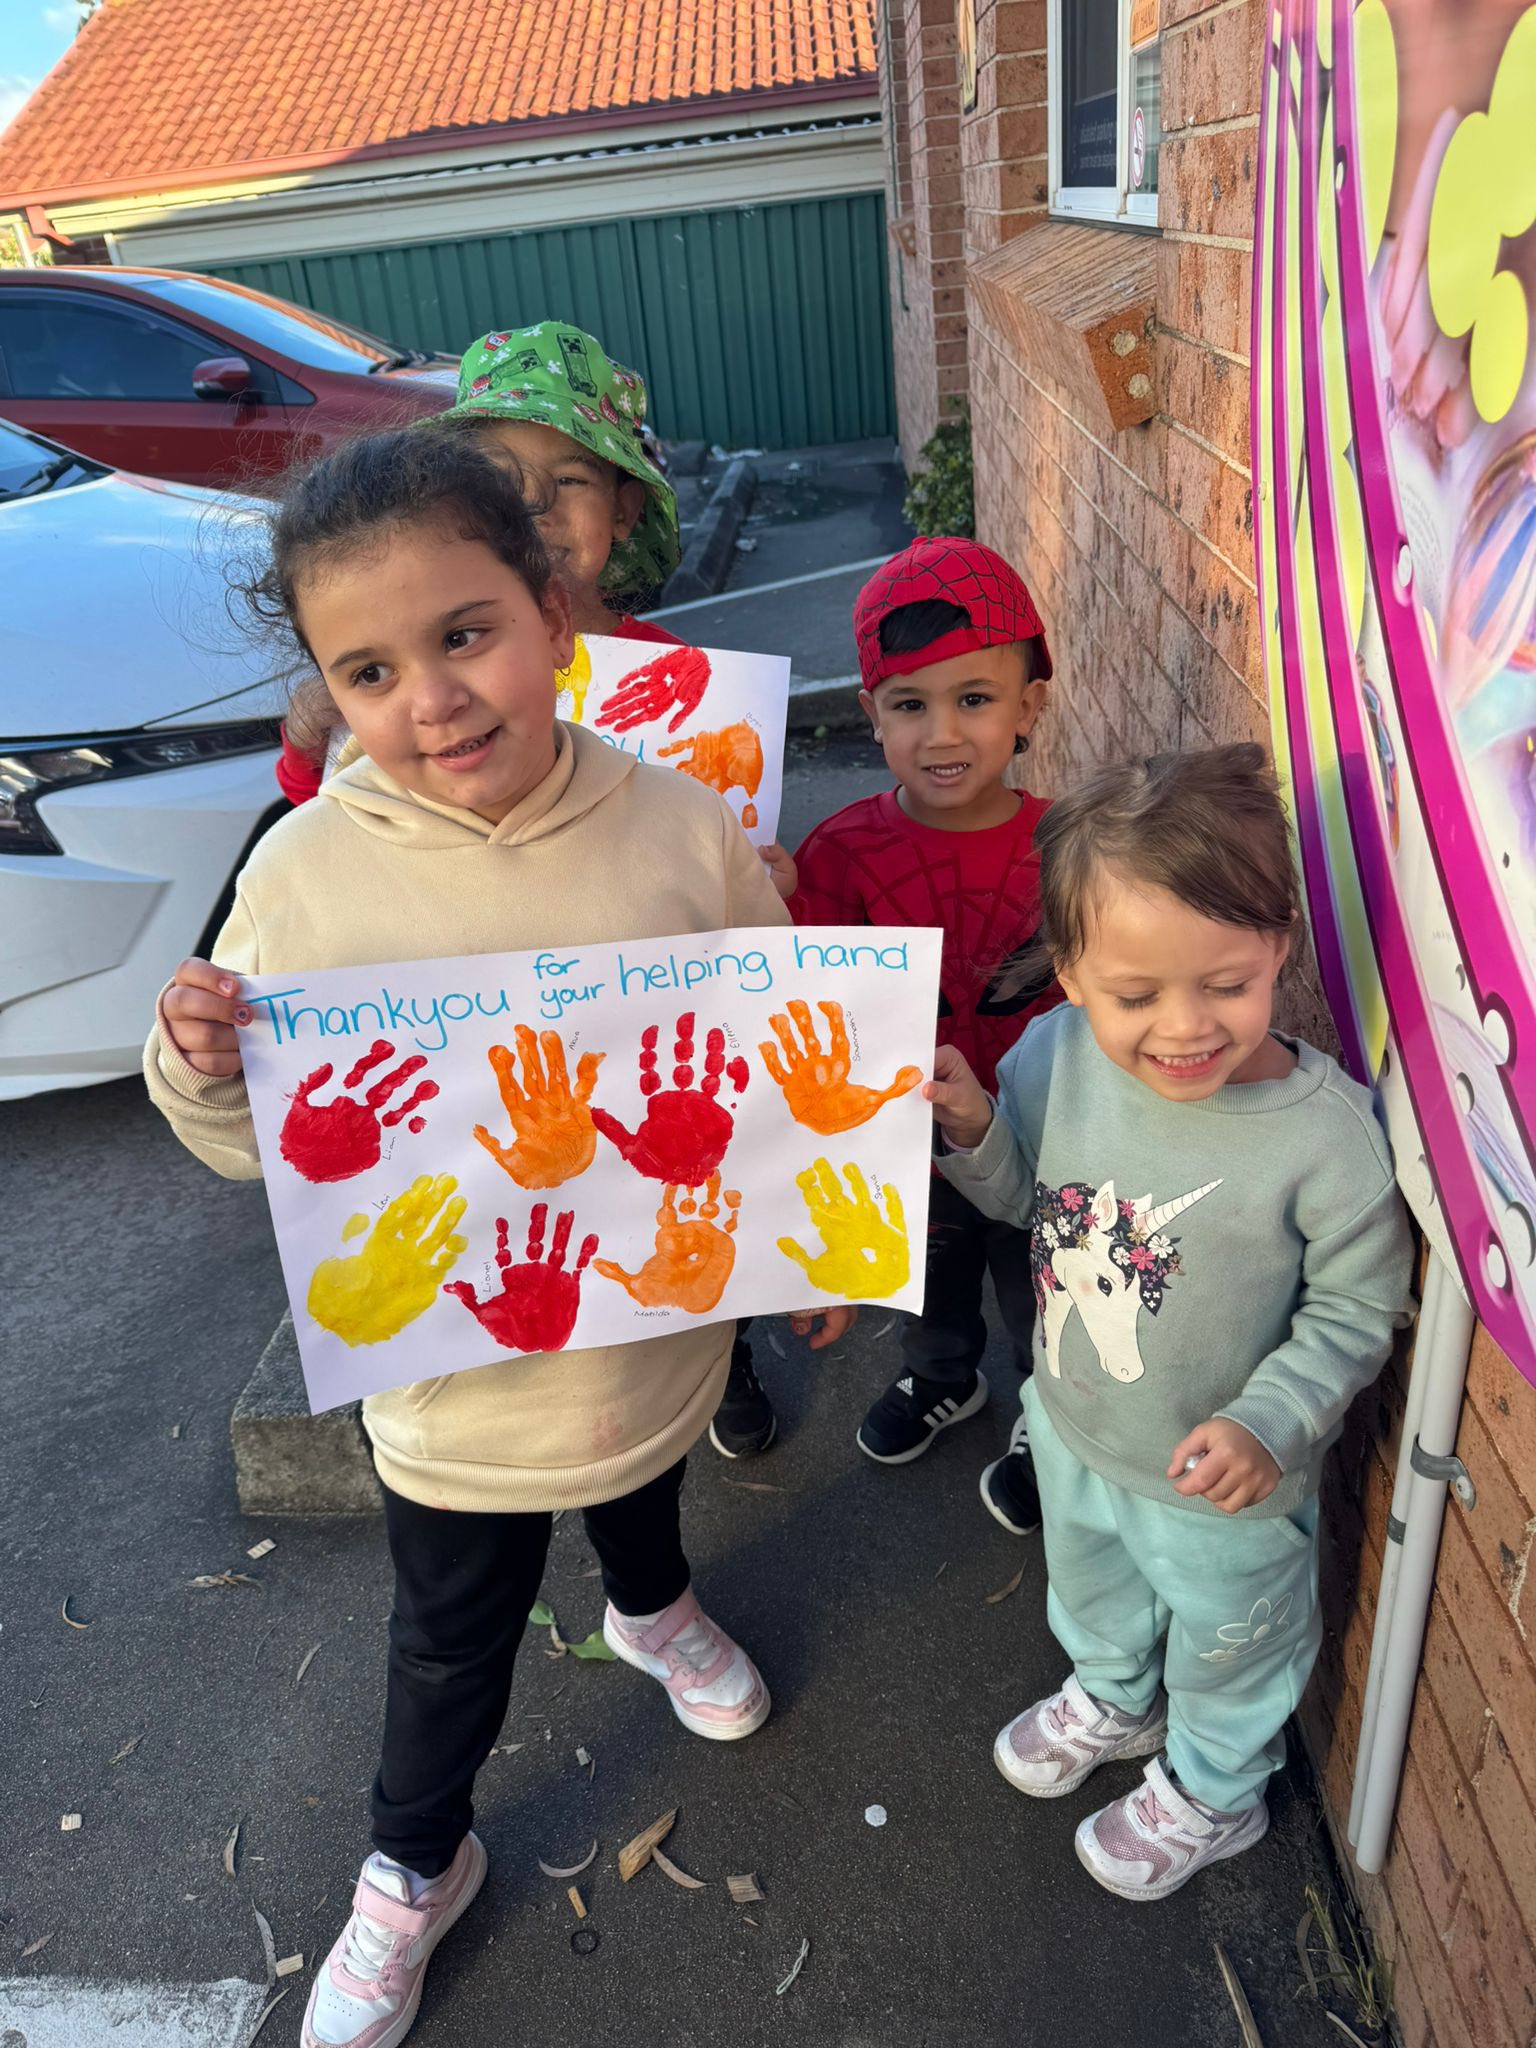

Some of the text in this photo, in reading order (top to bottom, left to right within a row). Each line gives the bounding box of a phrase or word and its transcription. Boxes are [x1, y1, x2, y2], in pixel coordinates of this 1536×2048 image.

[247, 935, 908, 1051] Thankyou for your helping hand
